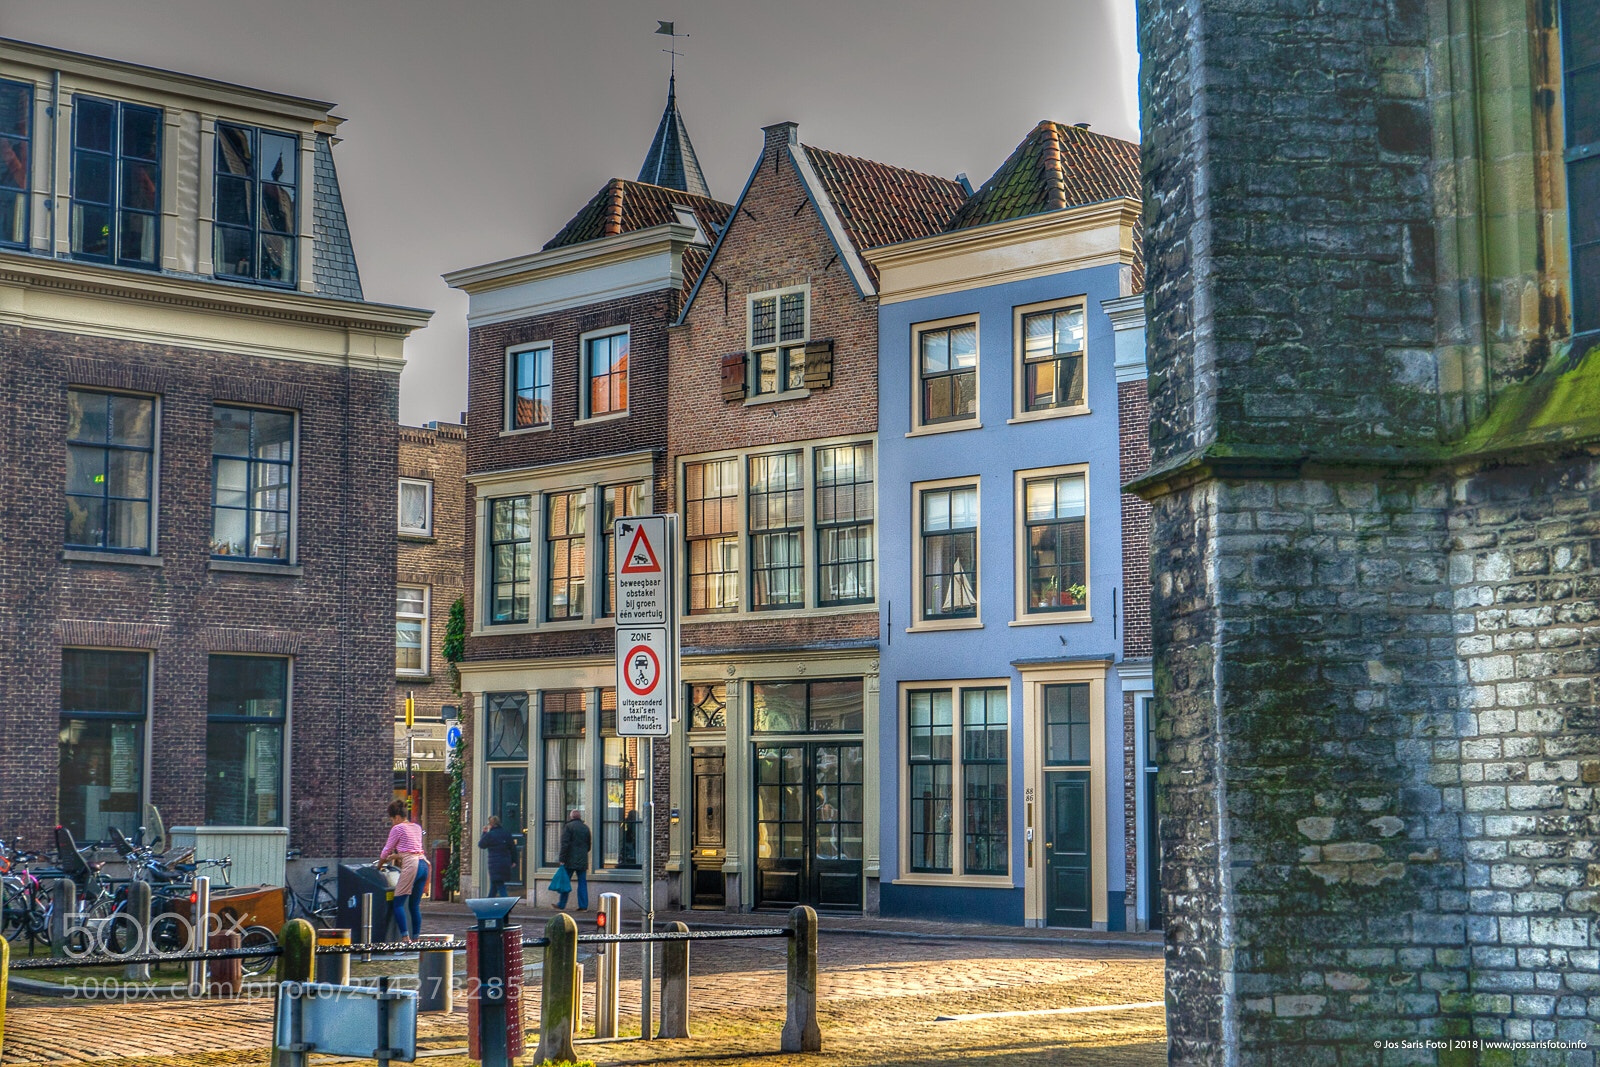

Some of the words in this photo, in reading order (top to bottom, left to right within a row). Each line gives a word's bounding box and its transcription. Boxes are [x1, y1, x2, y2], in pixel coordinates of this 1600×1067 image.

[620, 579, 661, 588] beweegbaar
[626, 589, 656, 598] obstakel
[626, 600, 635, 610] bij
[637, 600, 656, 610] groen
[620, 610, 632, 618] één
[634, 610, 663, 620] voertuig
[630, 632, 652, 641] ZONE
[622, 699, 663, 708] uitgezonderd
[629, 706, 647, 714] taxi's
[623, 715, 659, 724] ontheffing-
[637, 722, 662, 730] houders
